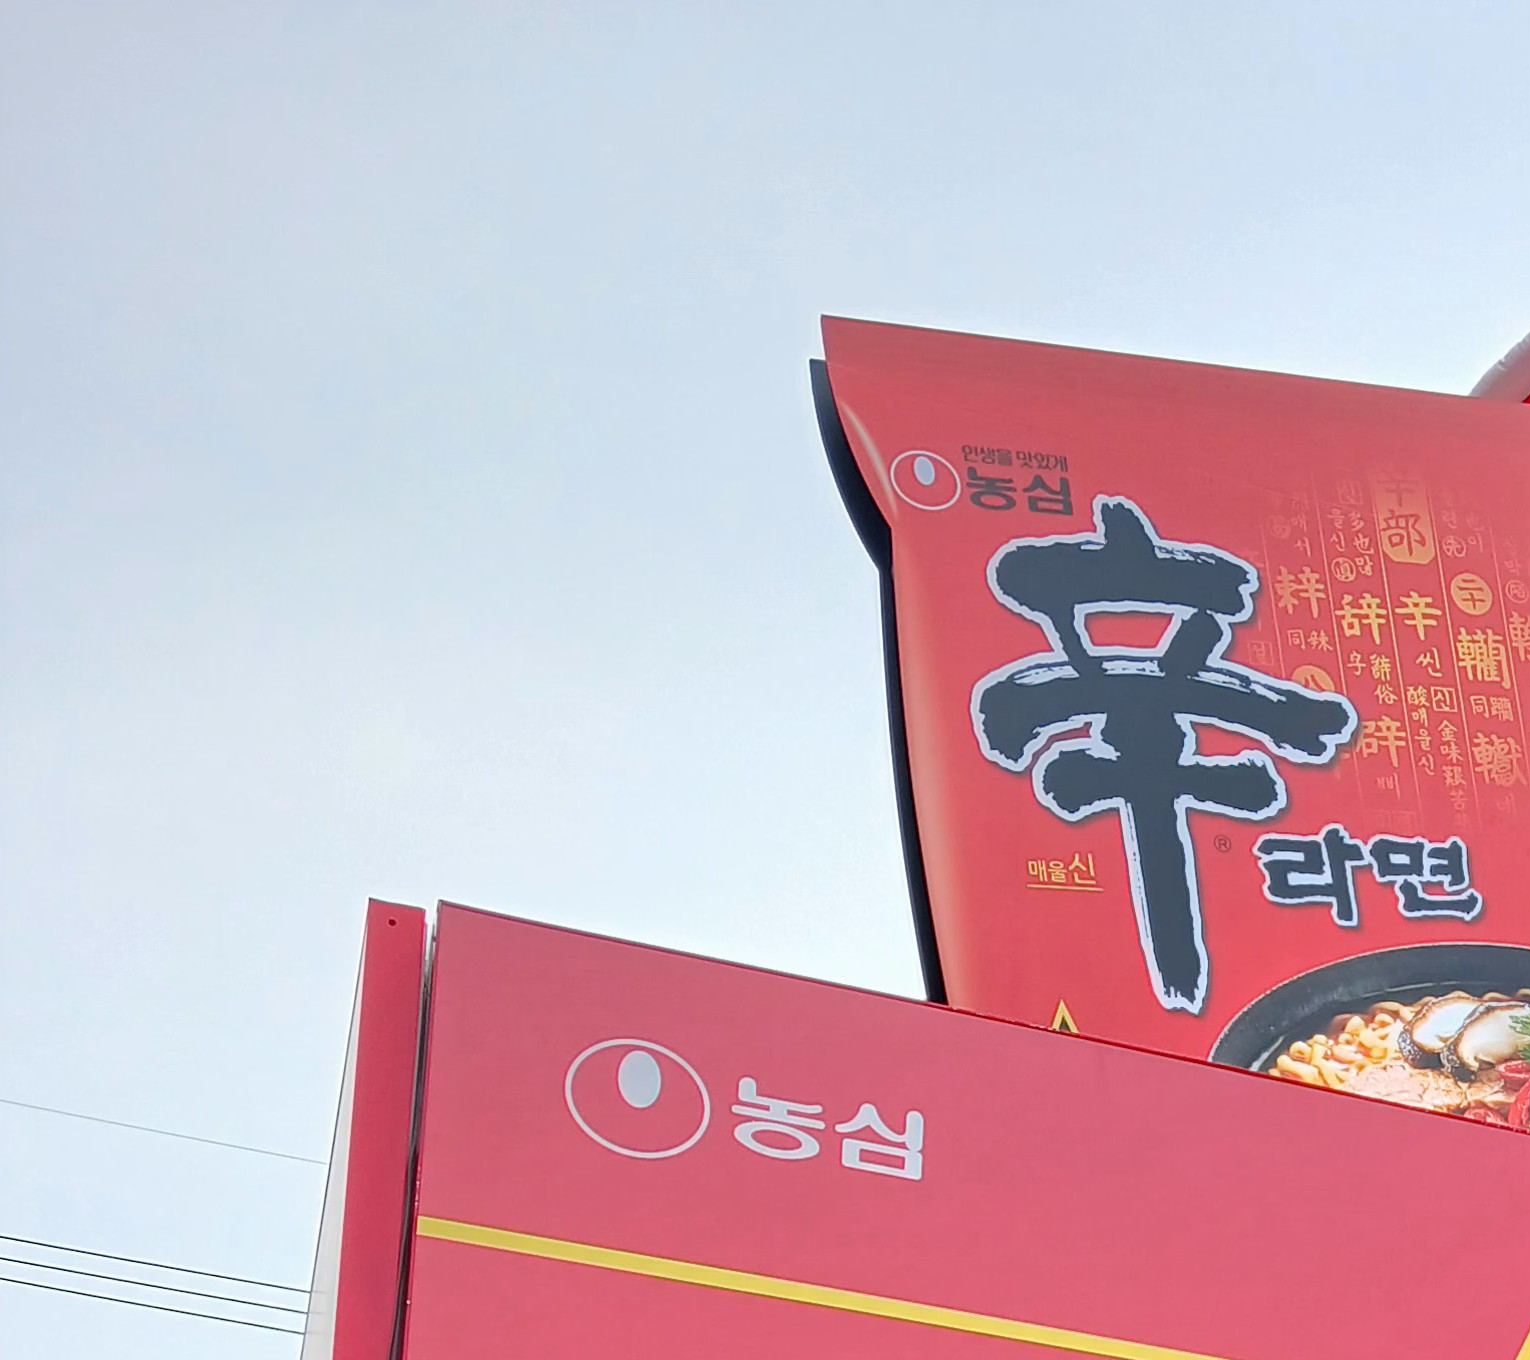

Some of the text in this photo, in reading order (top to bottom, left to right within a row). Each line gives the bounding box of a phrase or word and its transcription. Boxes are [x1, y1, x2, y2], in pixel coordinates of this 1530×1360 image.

[962, 445, 1069, 472] 인생을 맛있게
[966, 466, 1073, 515] 농심
[971, 495, 1482, 1015] 辛 라면
[1026, 853, 1096, 884] 매울신
[732, 1077, 924, 1181] 농심
